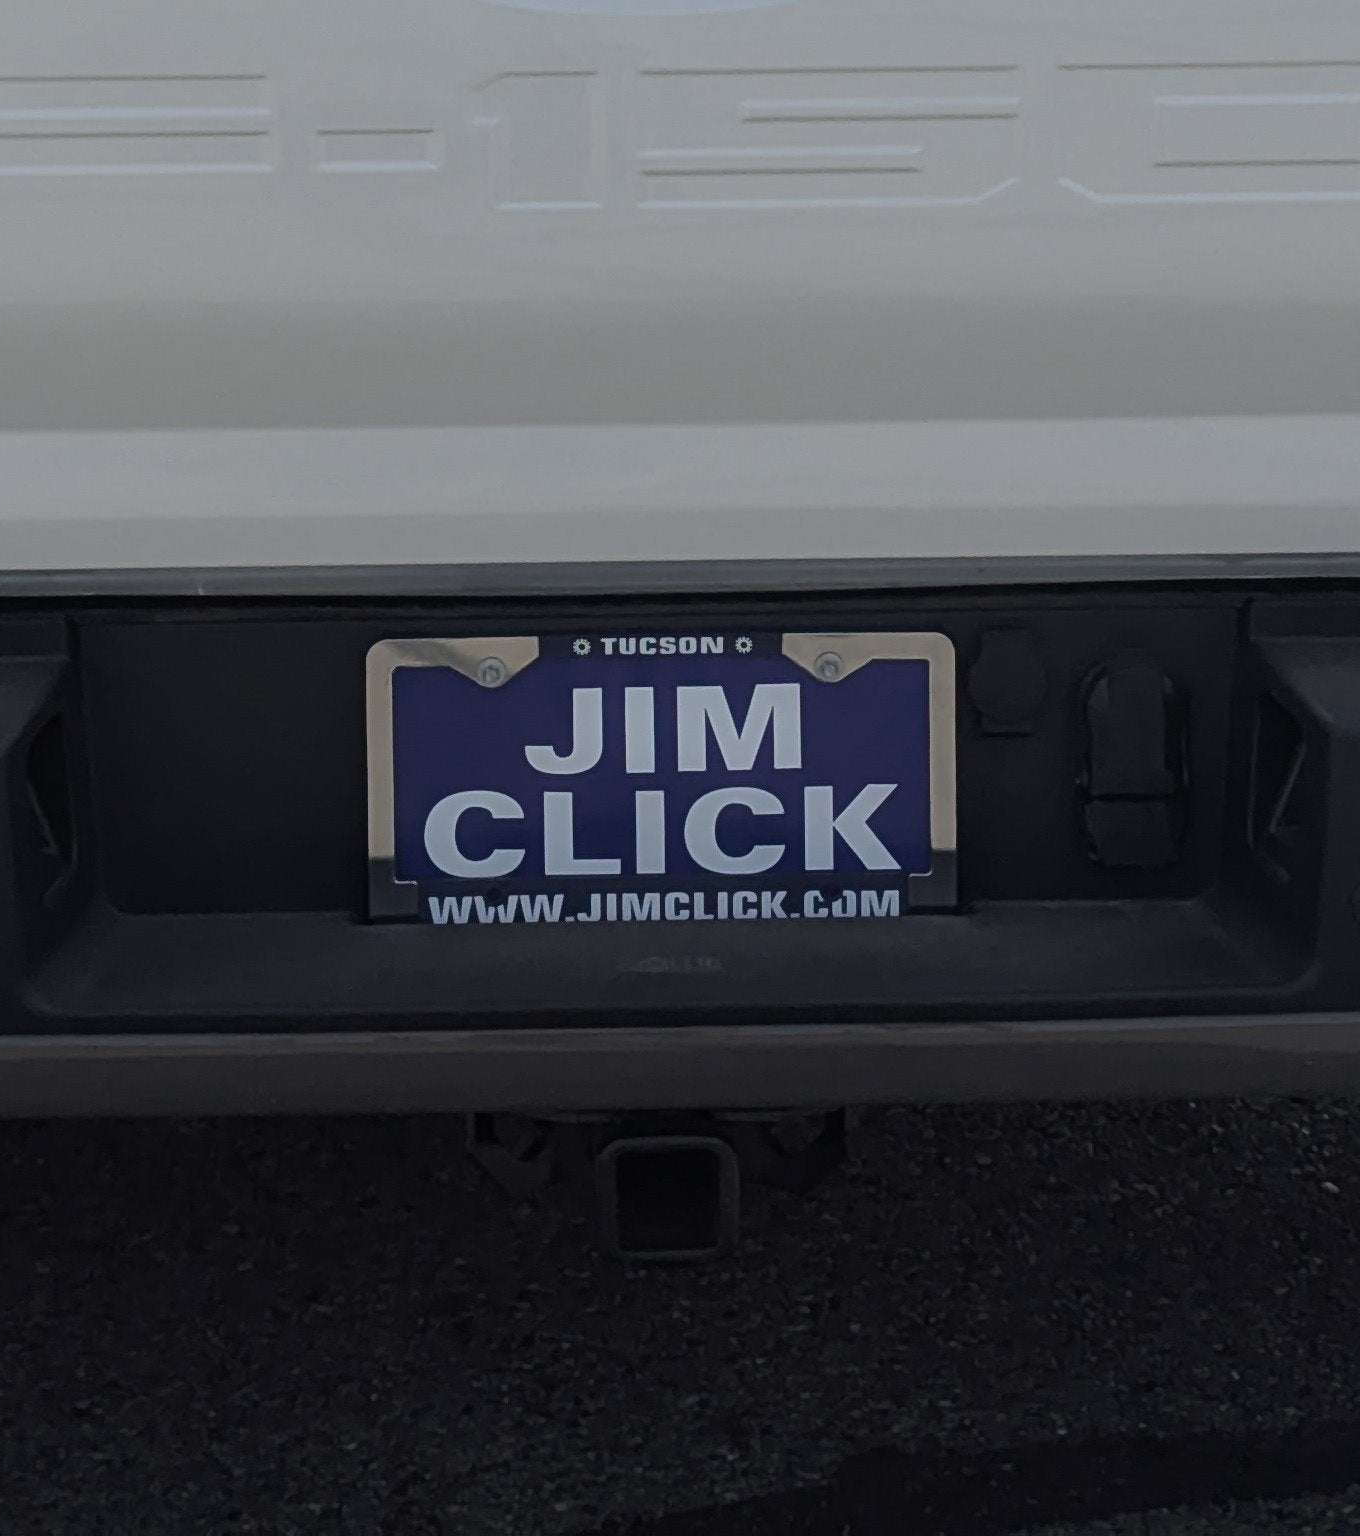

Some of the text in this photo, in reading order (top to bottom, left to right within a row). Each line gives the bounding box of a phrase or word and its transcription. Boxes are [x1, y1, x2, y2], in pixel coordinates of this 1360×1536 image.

[600, 636, 724, 655] TUCSON
[526, 683, 802, 775] JIM
[424, 783, 902, 878] CLICK
[428, 889, 900, 925] WWW.JIMCLICK.COM
